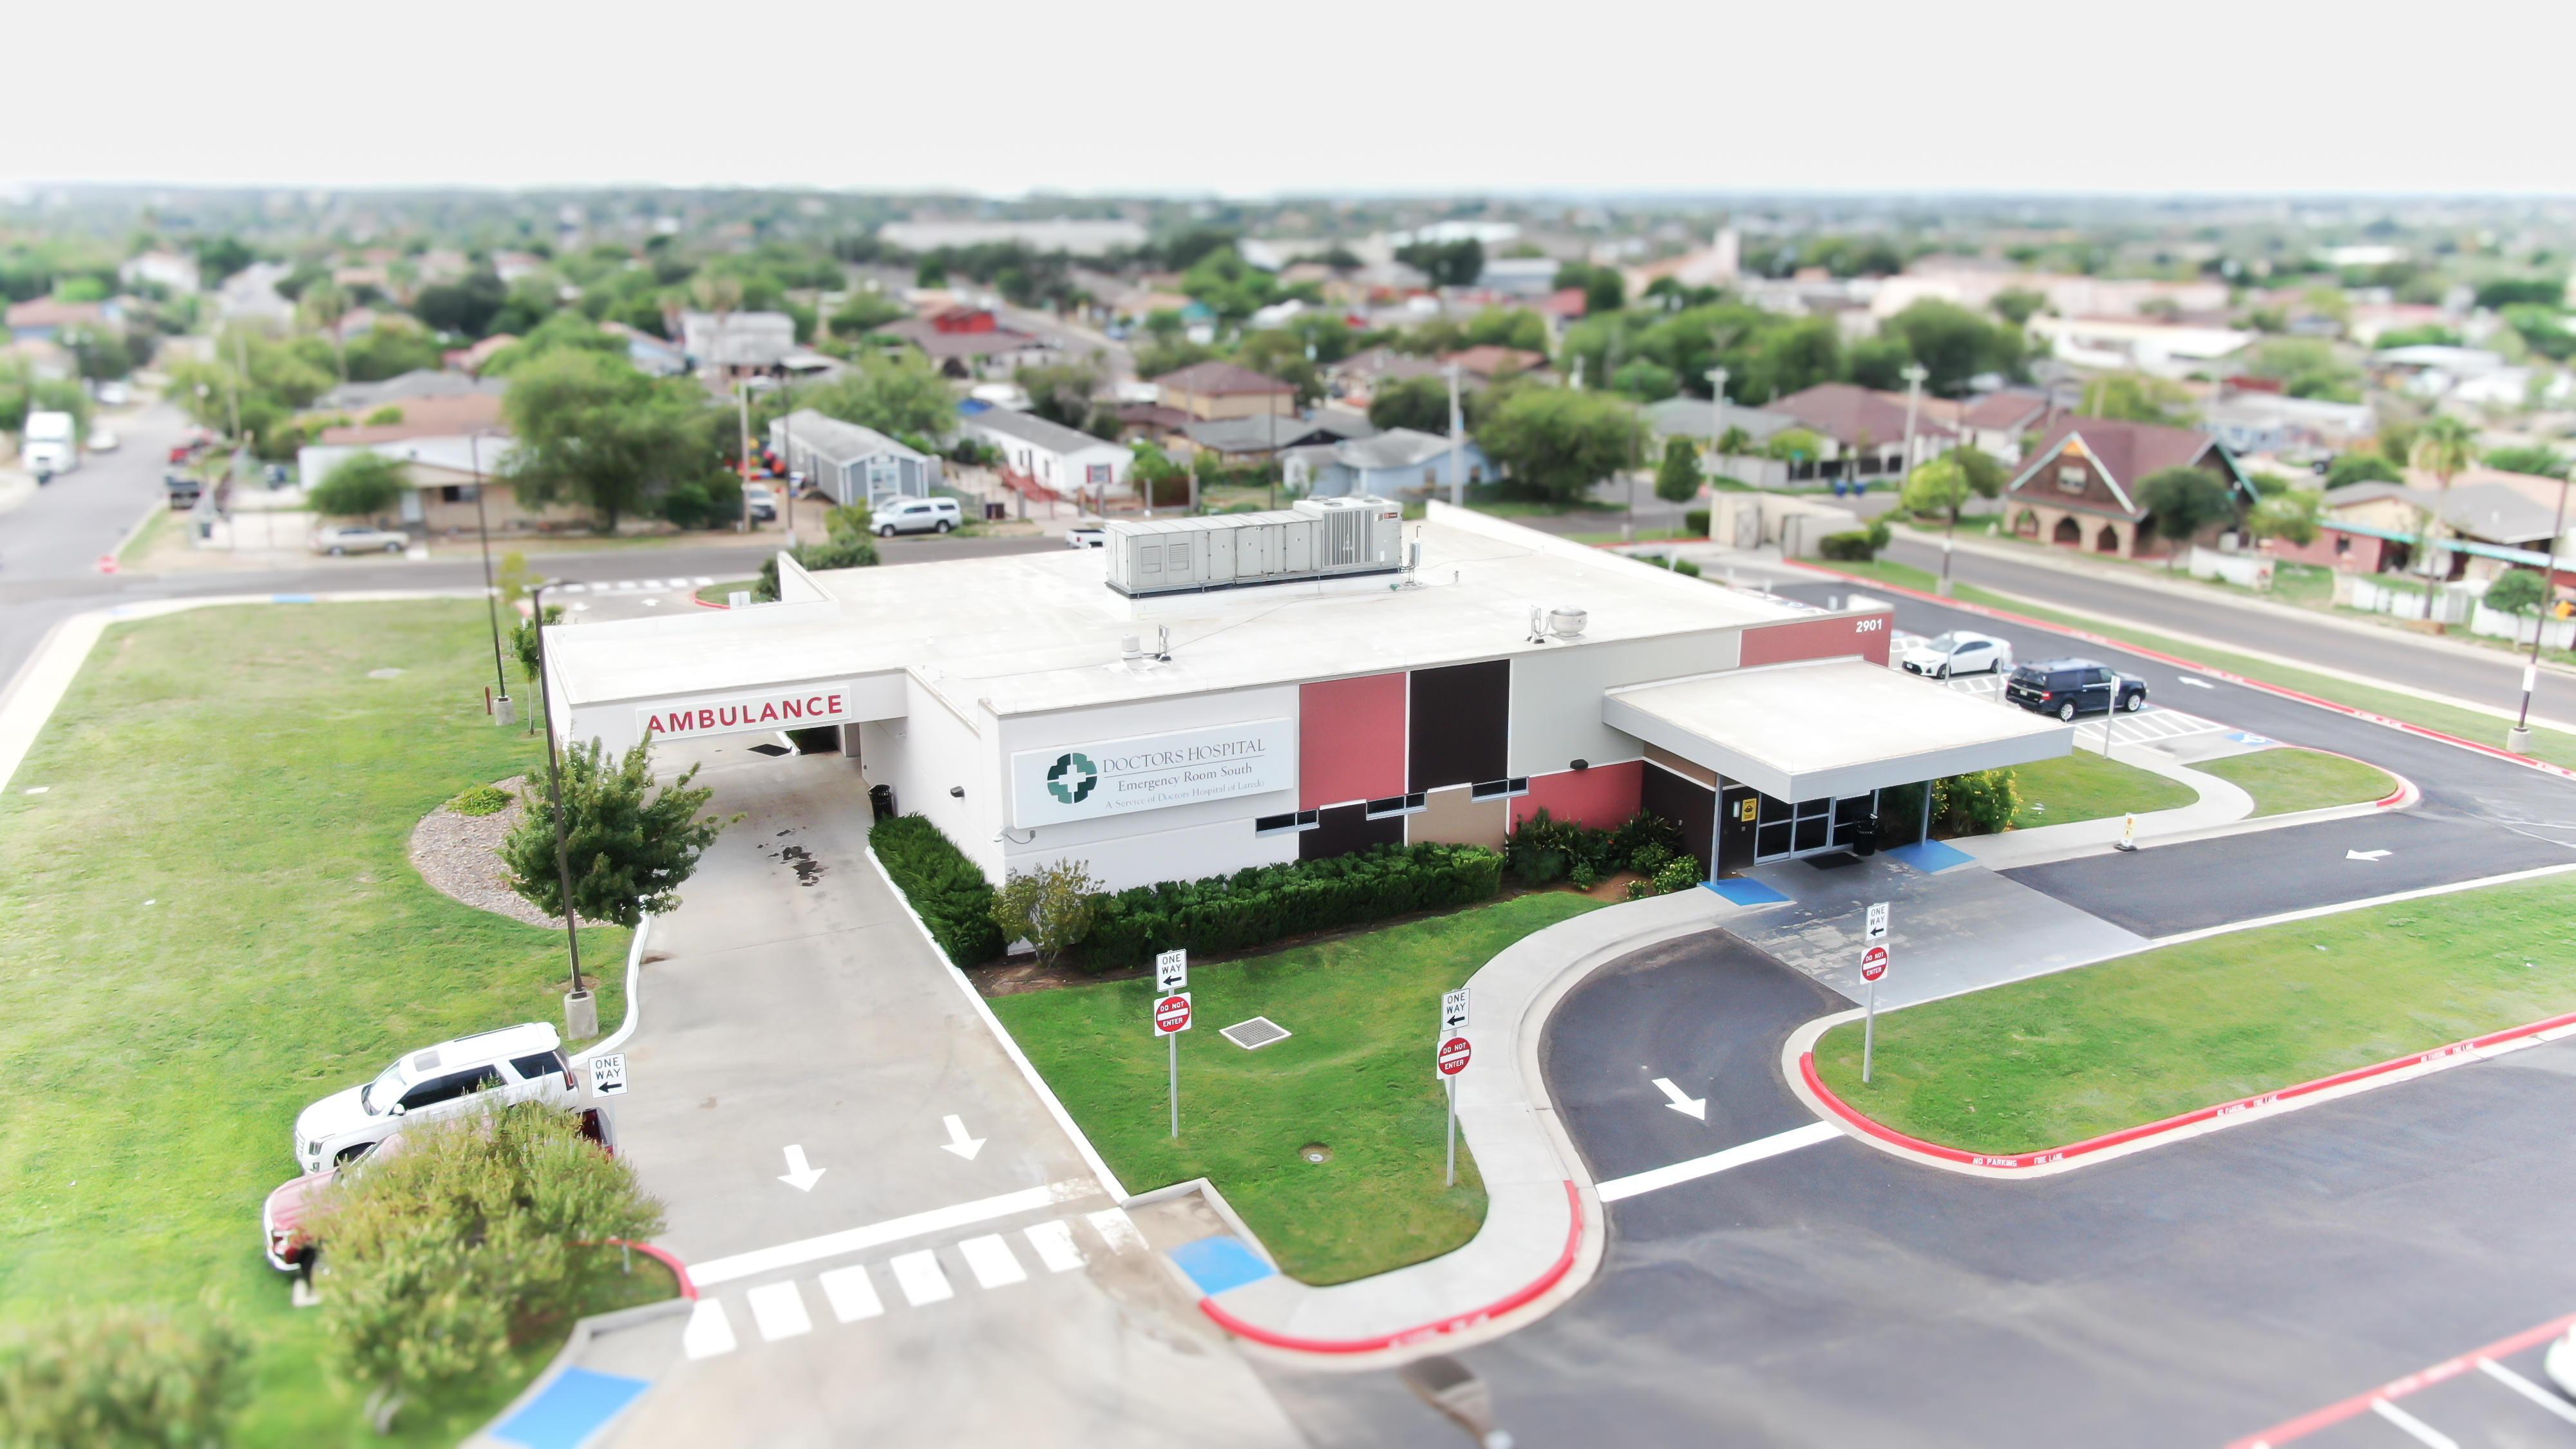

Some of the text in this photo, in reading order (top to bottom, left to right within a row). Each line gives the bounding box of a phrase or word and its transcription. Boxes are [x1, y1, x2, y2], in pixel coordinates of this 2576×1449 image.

[1855, 618, 1882, 632] 2901
[646, 694, 843, 733] AMBULANCE
[1103, 739, 1266, 773] DOCTORS HOSPITAL
[1119, 762, 1252, 791] Emergency Room South
[1105, 800, 1112, 809] A
[1115, 797, 1145, 807] Service
[1159, 792, 1189, 802] Doctors
[1193, 784, 1226, 797] Hospital
[1238, 779, 1264, 790] Laredo
[1871, 906, 1886, 916] ONE
[1870, 915, 1886, 925] WAY
[1162, 954, 1181, 965] ONE
[1162, 963, 1182, 974] WAY
[1447, 992, 1466, 1004] ONE
[1172, 1001, 1184, 1009] NOT
[1446, 1002, 1466, 1014] WAY
[1162, 1018, 1183, 1027] ENTER
[1454, 1042, 1466, 1051] NOT
[596, 1057, 620, 1068] ONE
[1444, 1059, 1464, 1070] ENTER
[596, 1068, 621, 1080] WAY
[1987, 1158, 2017, 1166] PARKING
[2034, 1156, 2047, 1164] FIRE
